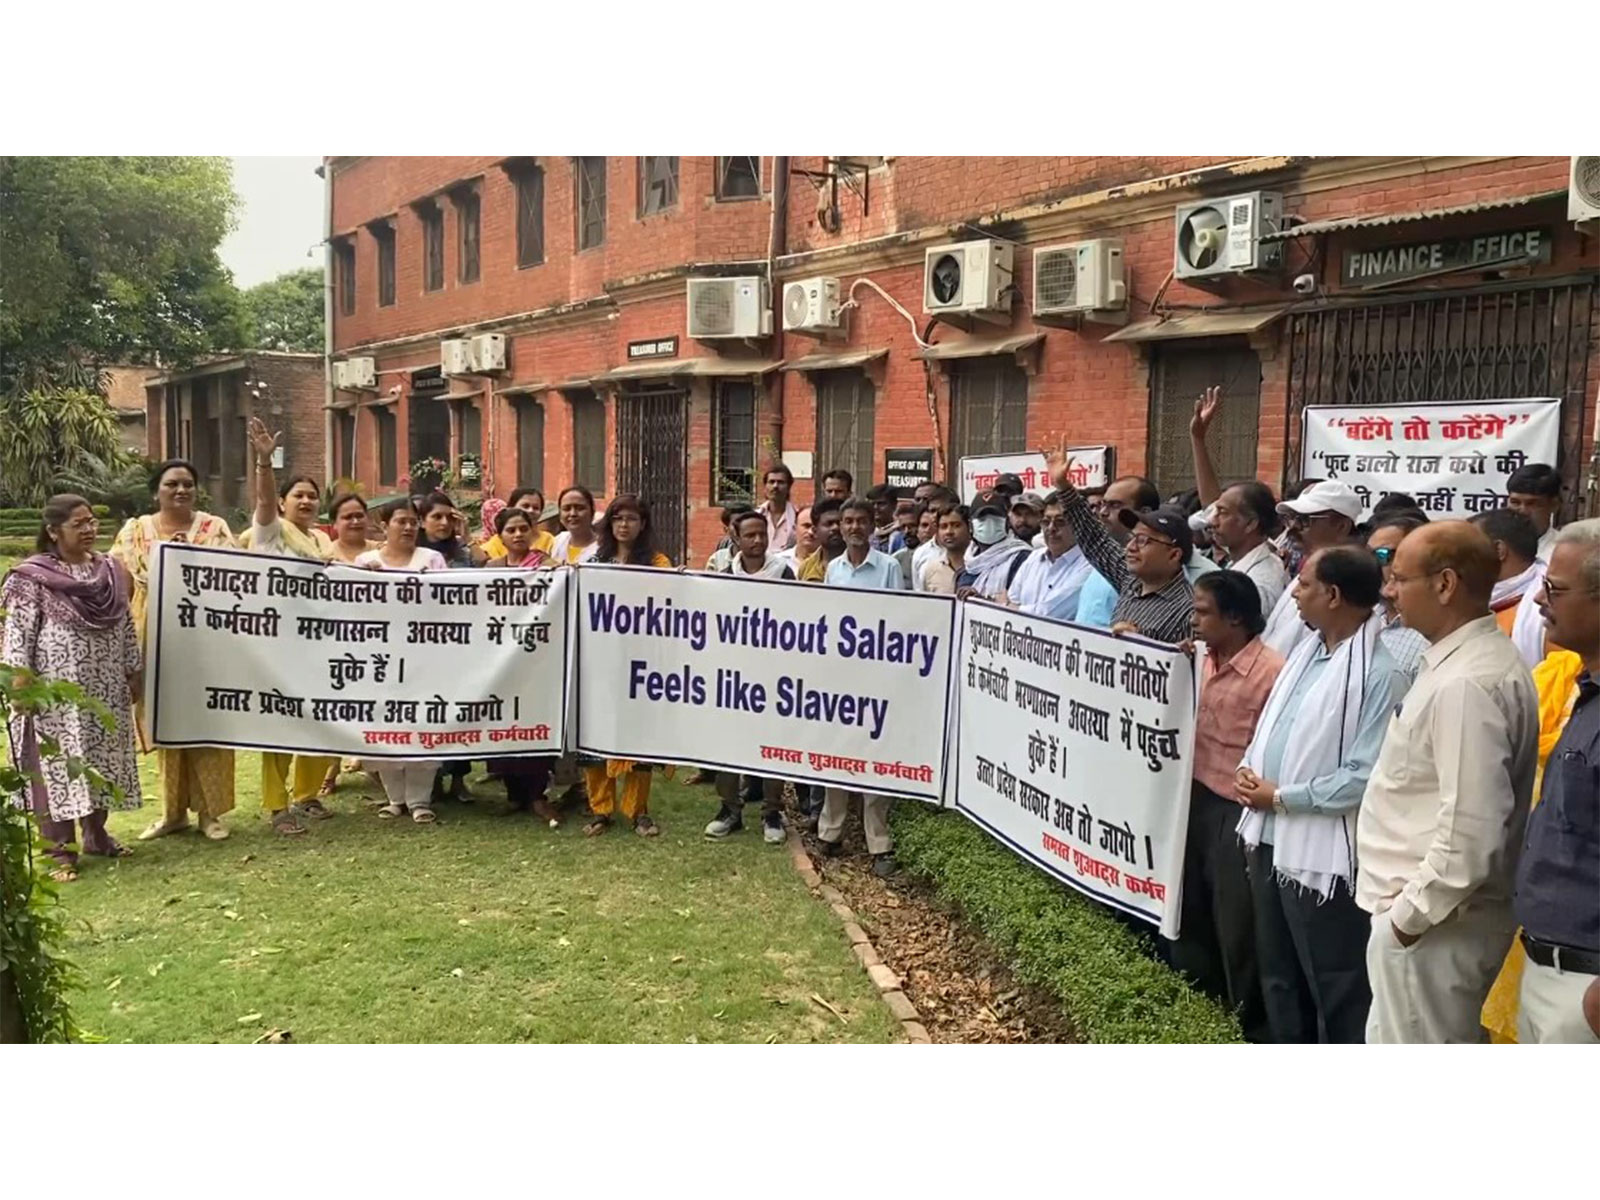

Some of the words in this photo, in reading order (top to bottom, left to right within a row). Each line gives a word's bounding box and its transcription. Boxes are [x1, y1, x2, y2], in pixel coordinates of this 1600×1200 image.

[1350, 244, 1443, 278] FINANCE
[1464, 231, 1541, 263] FFICE
[657, 341, 674, 353] OFFICE
[1401, 415, 1431, 441] तो
[888, 460, 906, 470] OFFICE
[907, 460, 915, 470] OF
[916, 460, 929, 470] THE
[1356, 450, 1400, 474] डालो
[1406, 456, 1442, 474] राज
[1449, 451, 1488, 474] करो
[1496, 450, 1528, 474] की
[1416, 487, 1457, 511] नहीं
[181, 563, 260, 600] शुआट्स
[267, 567, 389, 603] विश्वविद्यालय
[394, 576, 424, 604] की
[430, 583, 479, 605] गलत
[486, 578, 553, 606] नीतियों
[178, 598, 198, 628] से
[204, 604, 281, 637] कर्मचारी
[297, 616, 390, 643] मरणासन्न
[407, 621, 472, 645] अवस्था
[487, 616, 506, 644] में
[511, 616, 552, 652] पहुंच
[588, 592, 707, 651] Working
[716, 606, 828, 656] without
[837, 615, 939, 677] Salary
[329, 653, 366, 688] चुके
[373, 653, 390, 683] हैं
[1003, 620, 1063, 672] विश्वविद्यालय
[1065, 638, 1082, 678] की
[1084, 650, 1116, 688] गलत
[1120, 652, 1170, 705] नीतियों
[205, 687, 252, 712] उत्तर
[258, 688, 305, 719] प्रदेश
[311, 698, 376, 722] सरकार
[384, 700, 418, 724] अब
[425, 694, 448, 724] तो
[455, 694, 504, 723] जागो
[629, 660, 706, 705] Feels
[716, 668, 766, 713] like
[776, 676, 888, 739] Slavery
[968, 655, 976, 688] से
[978, 662, 1009, 702] कर्मचारी
[1015, 679, 1061, 723] मरणासन्न
[1068, 699, 1110, 742] अवस्था
[1119, 707, 1134, 751] में
[363, 730, 412, 744] समस्त
[487, 725, 551, 742] कर्मचारी
[1028, 729, 1047, 774] चुके
[1048, 733, 1060, 774] हैं
[760, 745, 803, 763] समस्त
[873, 760, 933, 783] कर्मचारी
[996, 761, 1017, 802] प्रदेश
[1019, 779, 1050, 822] सरकार
[1054, 798, 1074, 835] अब
[1077, 803, 1093, 845] तो
[1098, 820, 1137, 865] जागो
[1042, 832, 1070, 862] समस्त
